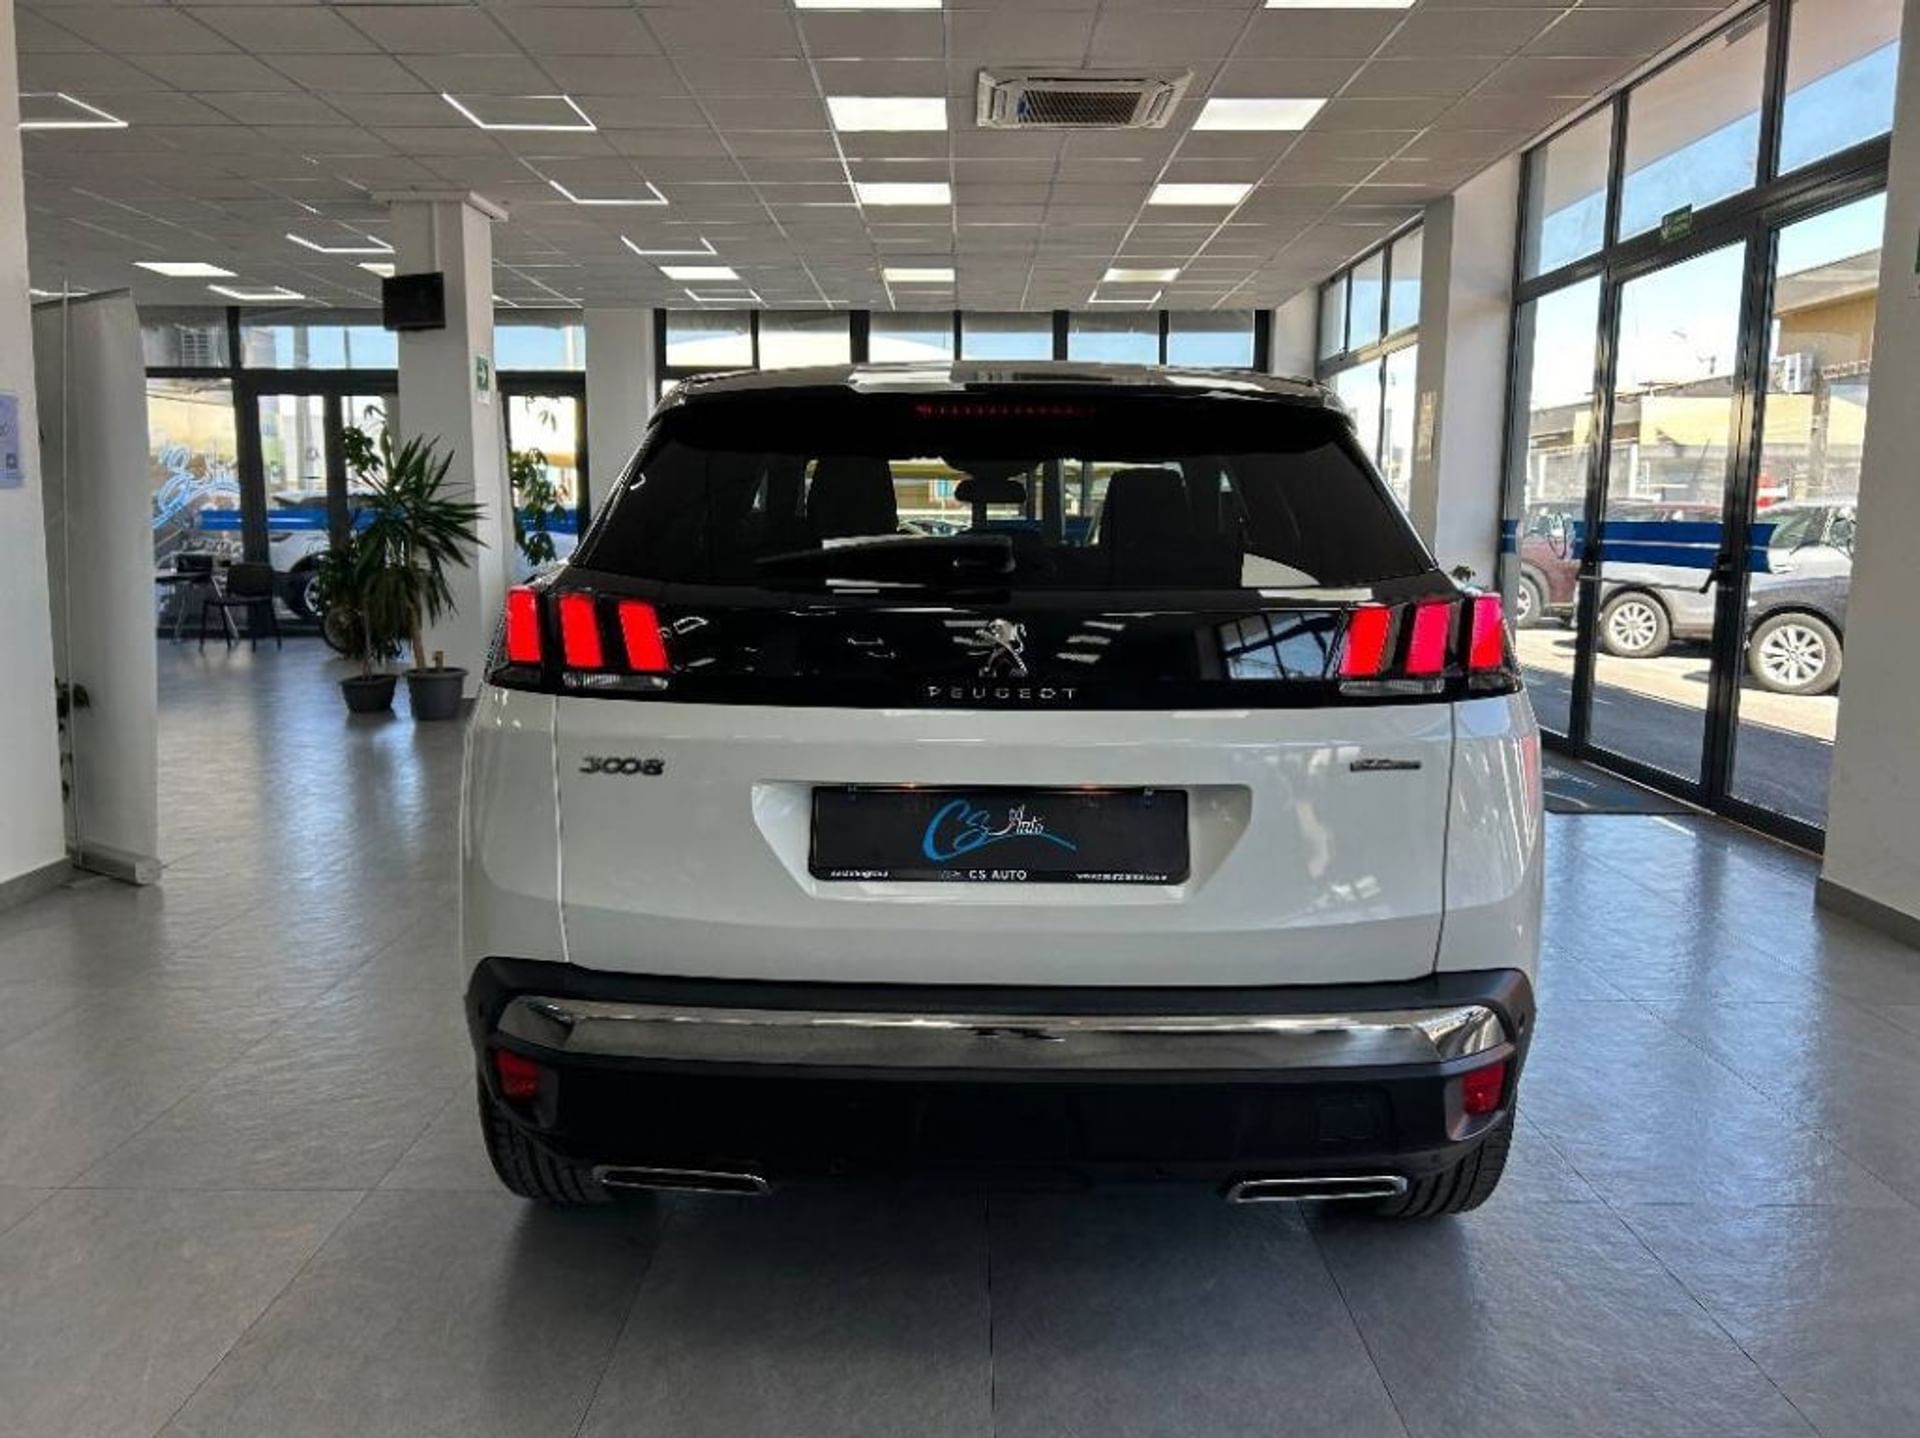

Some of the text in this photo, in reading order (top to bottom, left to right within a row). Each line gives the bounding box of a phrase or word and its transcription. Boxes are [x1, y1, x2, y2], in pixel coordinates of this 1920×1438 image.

[927, 685, 1077, 700] PEUGEOT
[579, 757, 665, 776] 3008
[968, 869, 986, 881] CS
[991, 869, 1027, 881] AUTO
